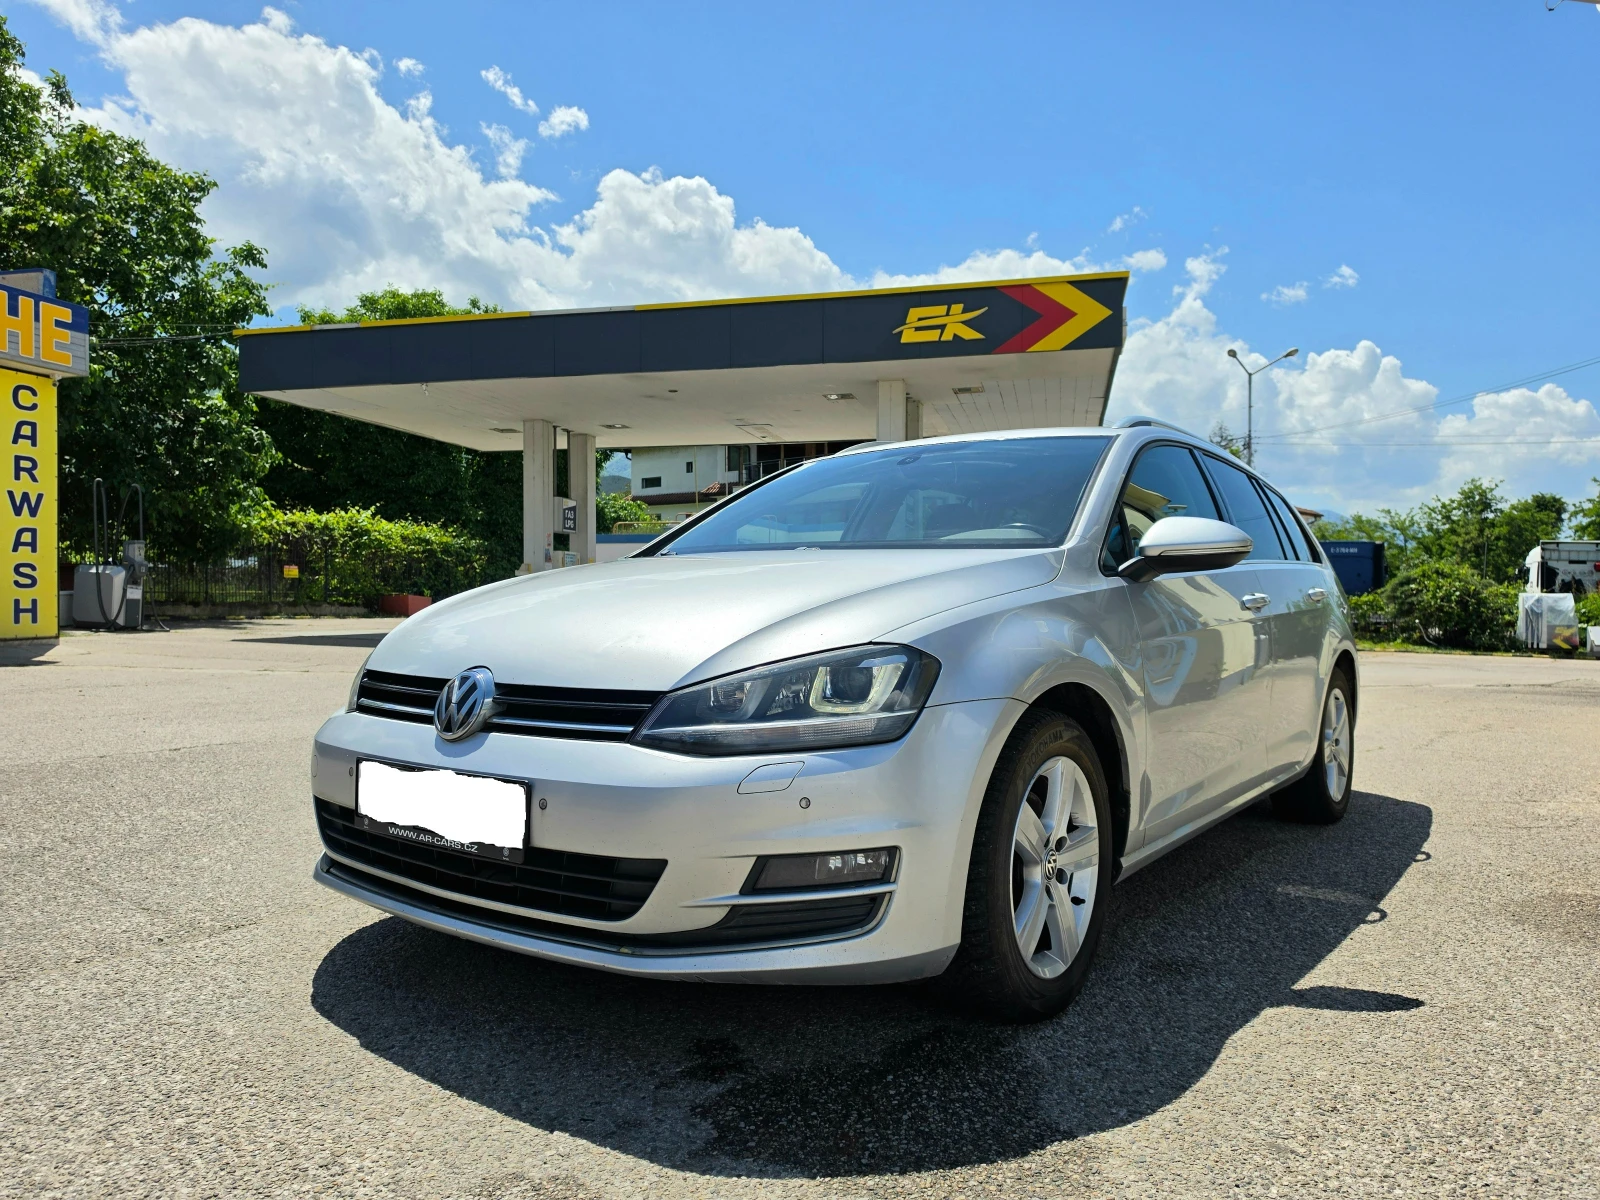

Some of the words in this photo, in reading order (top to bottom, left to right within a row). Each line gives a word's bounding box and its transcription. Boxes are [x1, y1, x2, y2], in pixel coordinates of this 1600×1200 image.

[0, 289, 72, 367] HE
[7, 384, 44, 625] CARWASH
[565, 519, 575, 529] LPG
[1026, 729, 1064, 768] YOKOHAMA
[388, 826, 479, 853] WWW.AR-CARS.CZ
